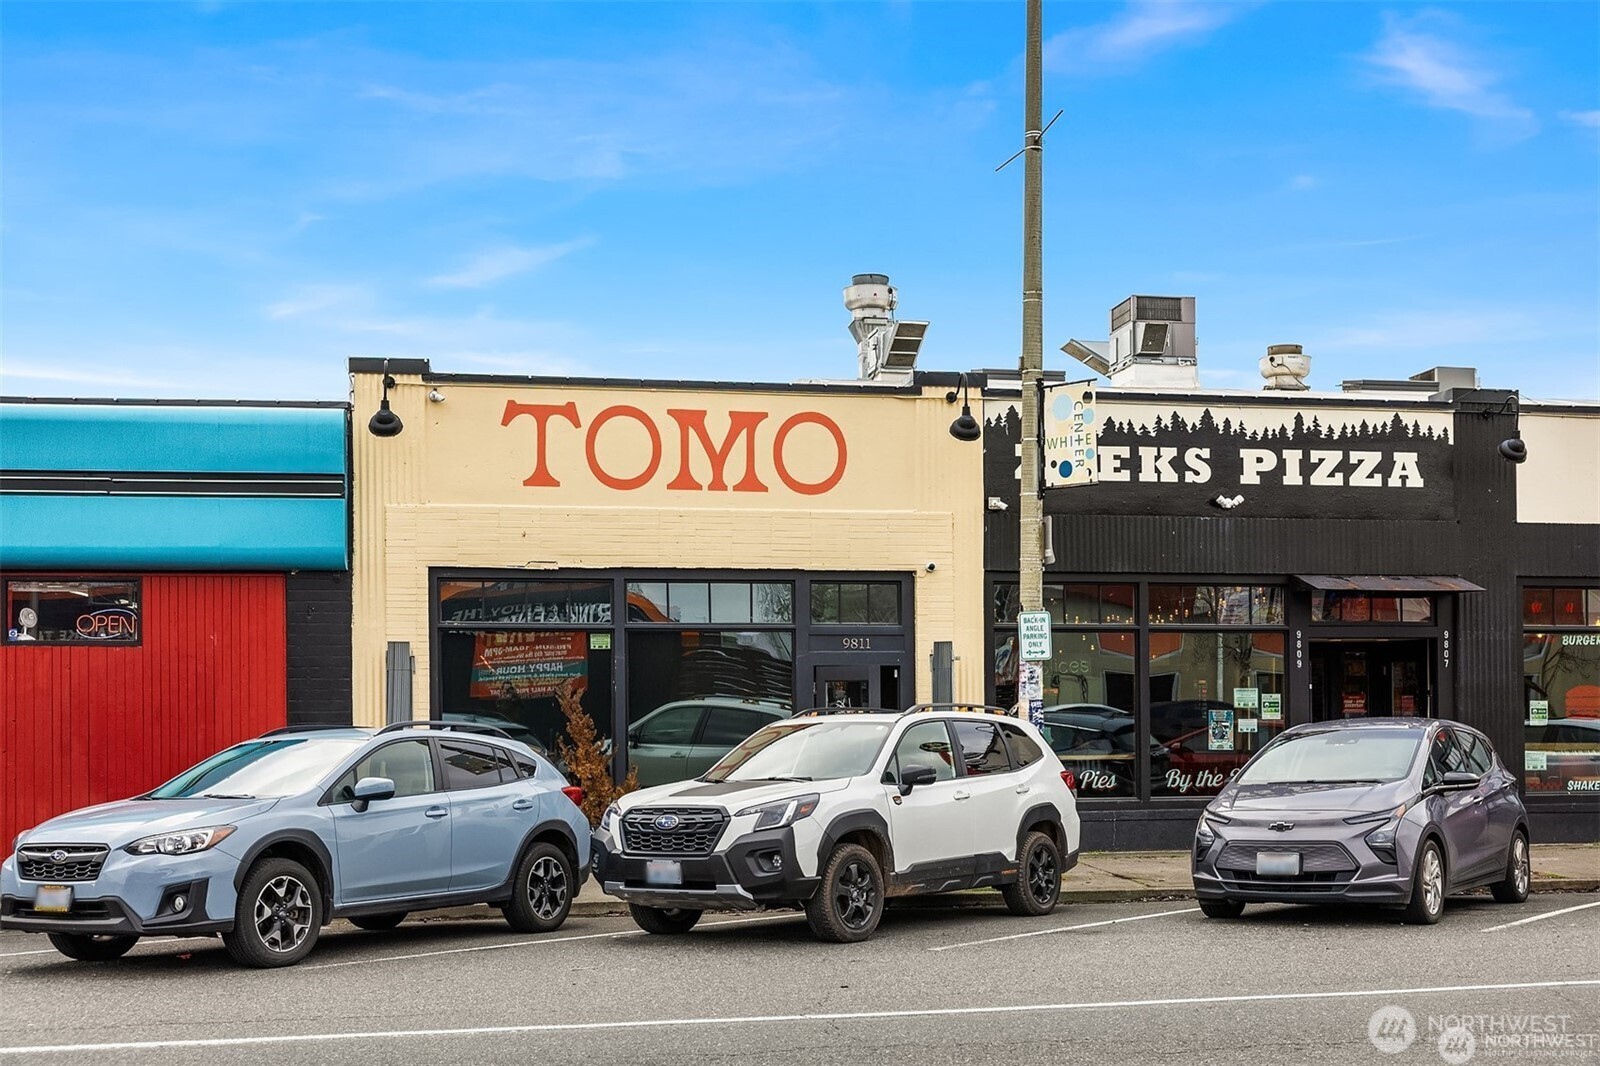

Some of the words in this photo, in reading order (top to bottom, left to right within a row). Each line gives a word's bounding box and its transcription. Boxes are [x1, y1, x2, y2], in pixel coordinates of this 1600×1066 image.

[1047, 433, 1091, 449] WHITE
[1073, 401, 1084, 467] CENTER
[501, 400, 847, 495] TOMO
[1240, 449, 1424, 487] PIZZA
[76, 614, 135, 633] OPEN
[842, 637, 871, 649] 9811
[1079, 770, 1117, 789] Pies
[1165, 768, 1192, 793] By
[1195, 769, 1223, 787] the
[1567, 780, 1600, 791] SHAKE
